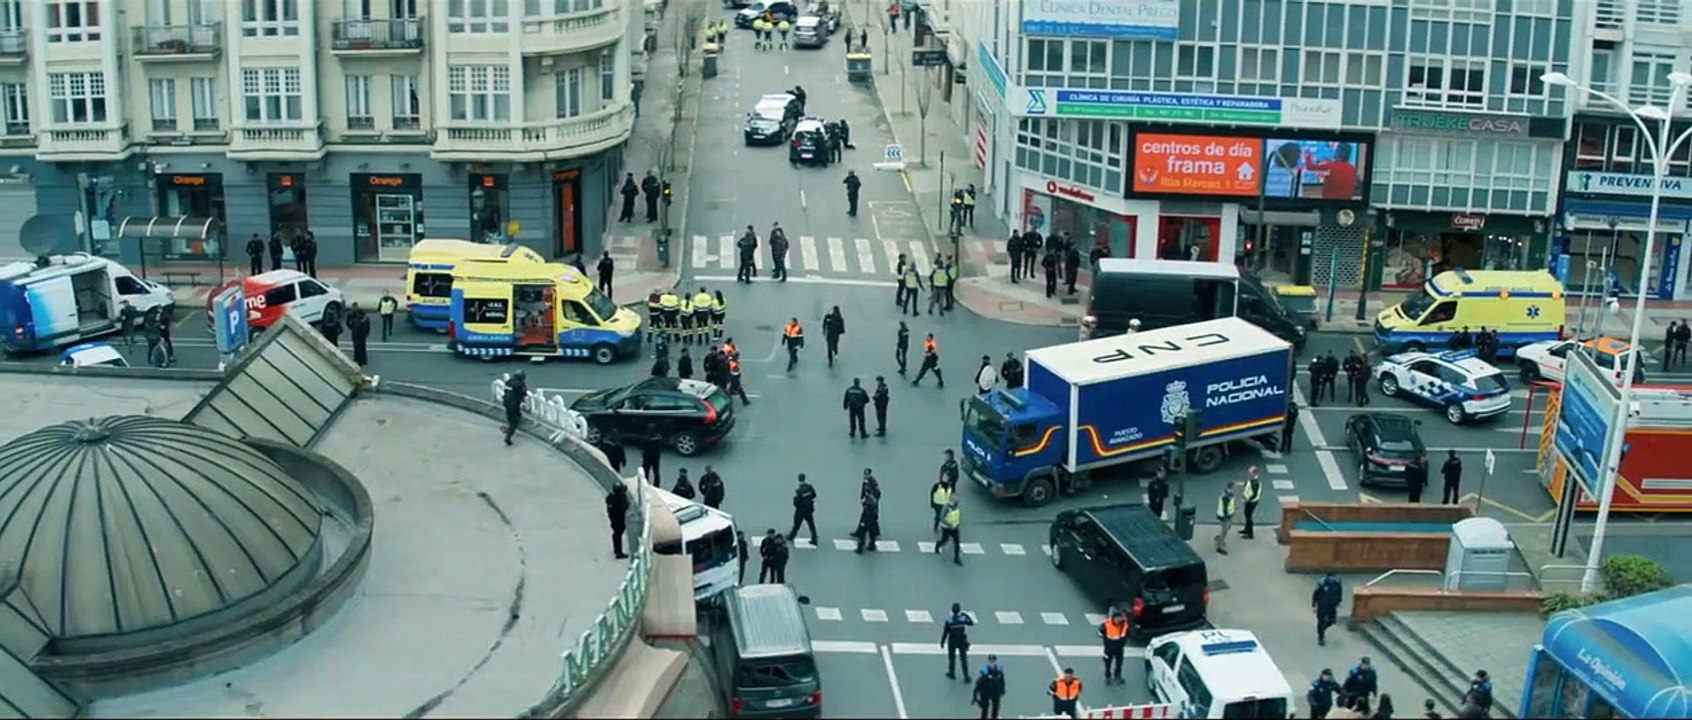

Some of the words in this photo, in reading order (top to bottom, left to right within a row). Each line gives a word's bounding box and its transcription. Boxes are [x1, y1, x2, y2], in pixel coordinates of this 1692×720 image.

[1142, 141, 1201, 155] centros
[1205, 143, 1225, 156] de
[1228, 143, 1253, 157] día
[1167, 156, 1226, 175] frama
[1599, 176, 1681, 191] PREVENIVA
[229, 310, 240, 335] P
[1206, 374, 1268, 395] POLICIA
[1205, 386, 1285, 408] NACIONAL
